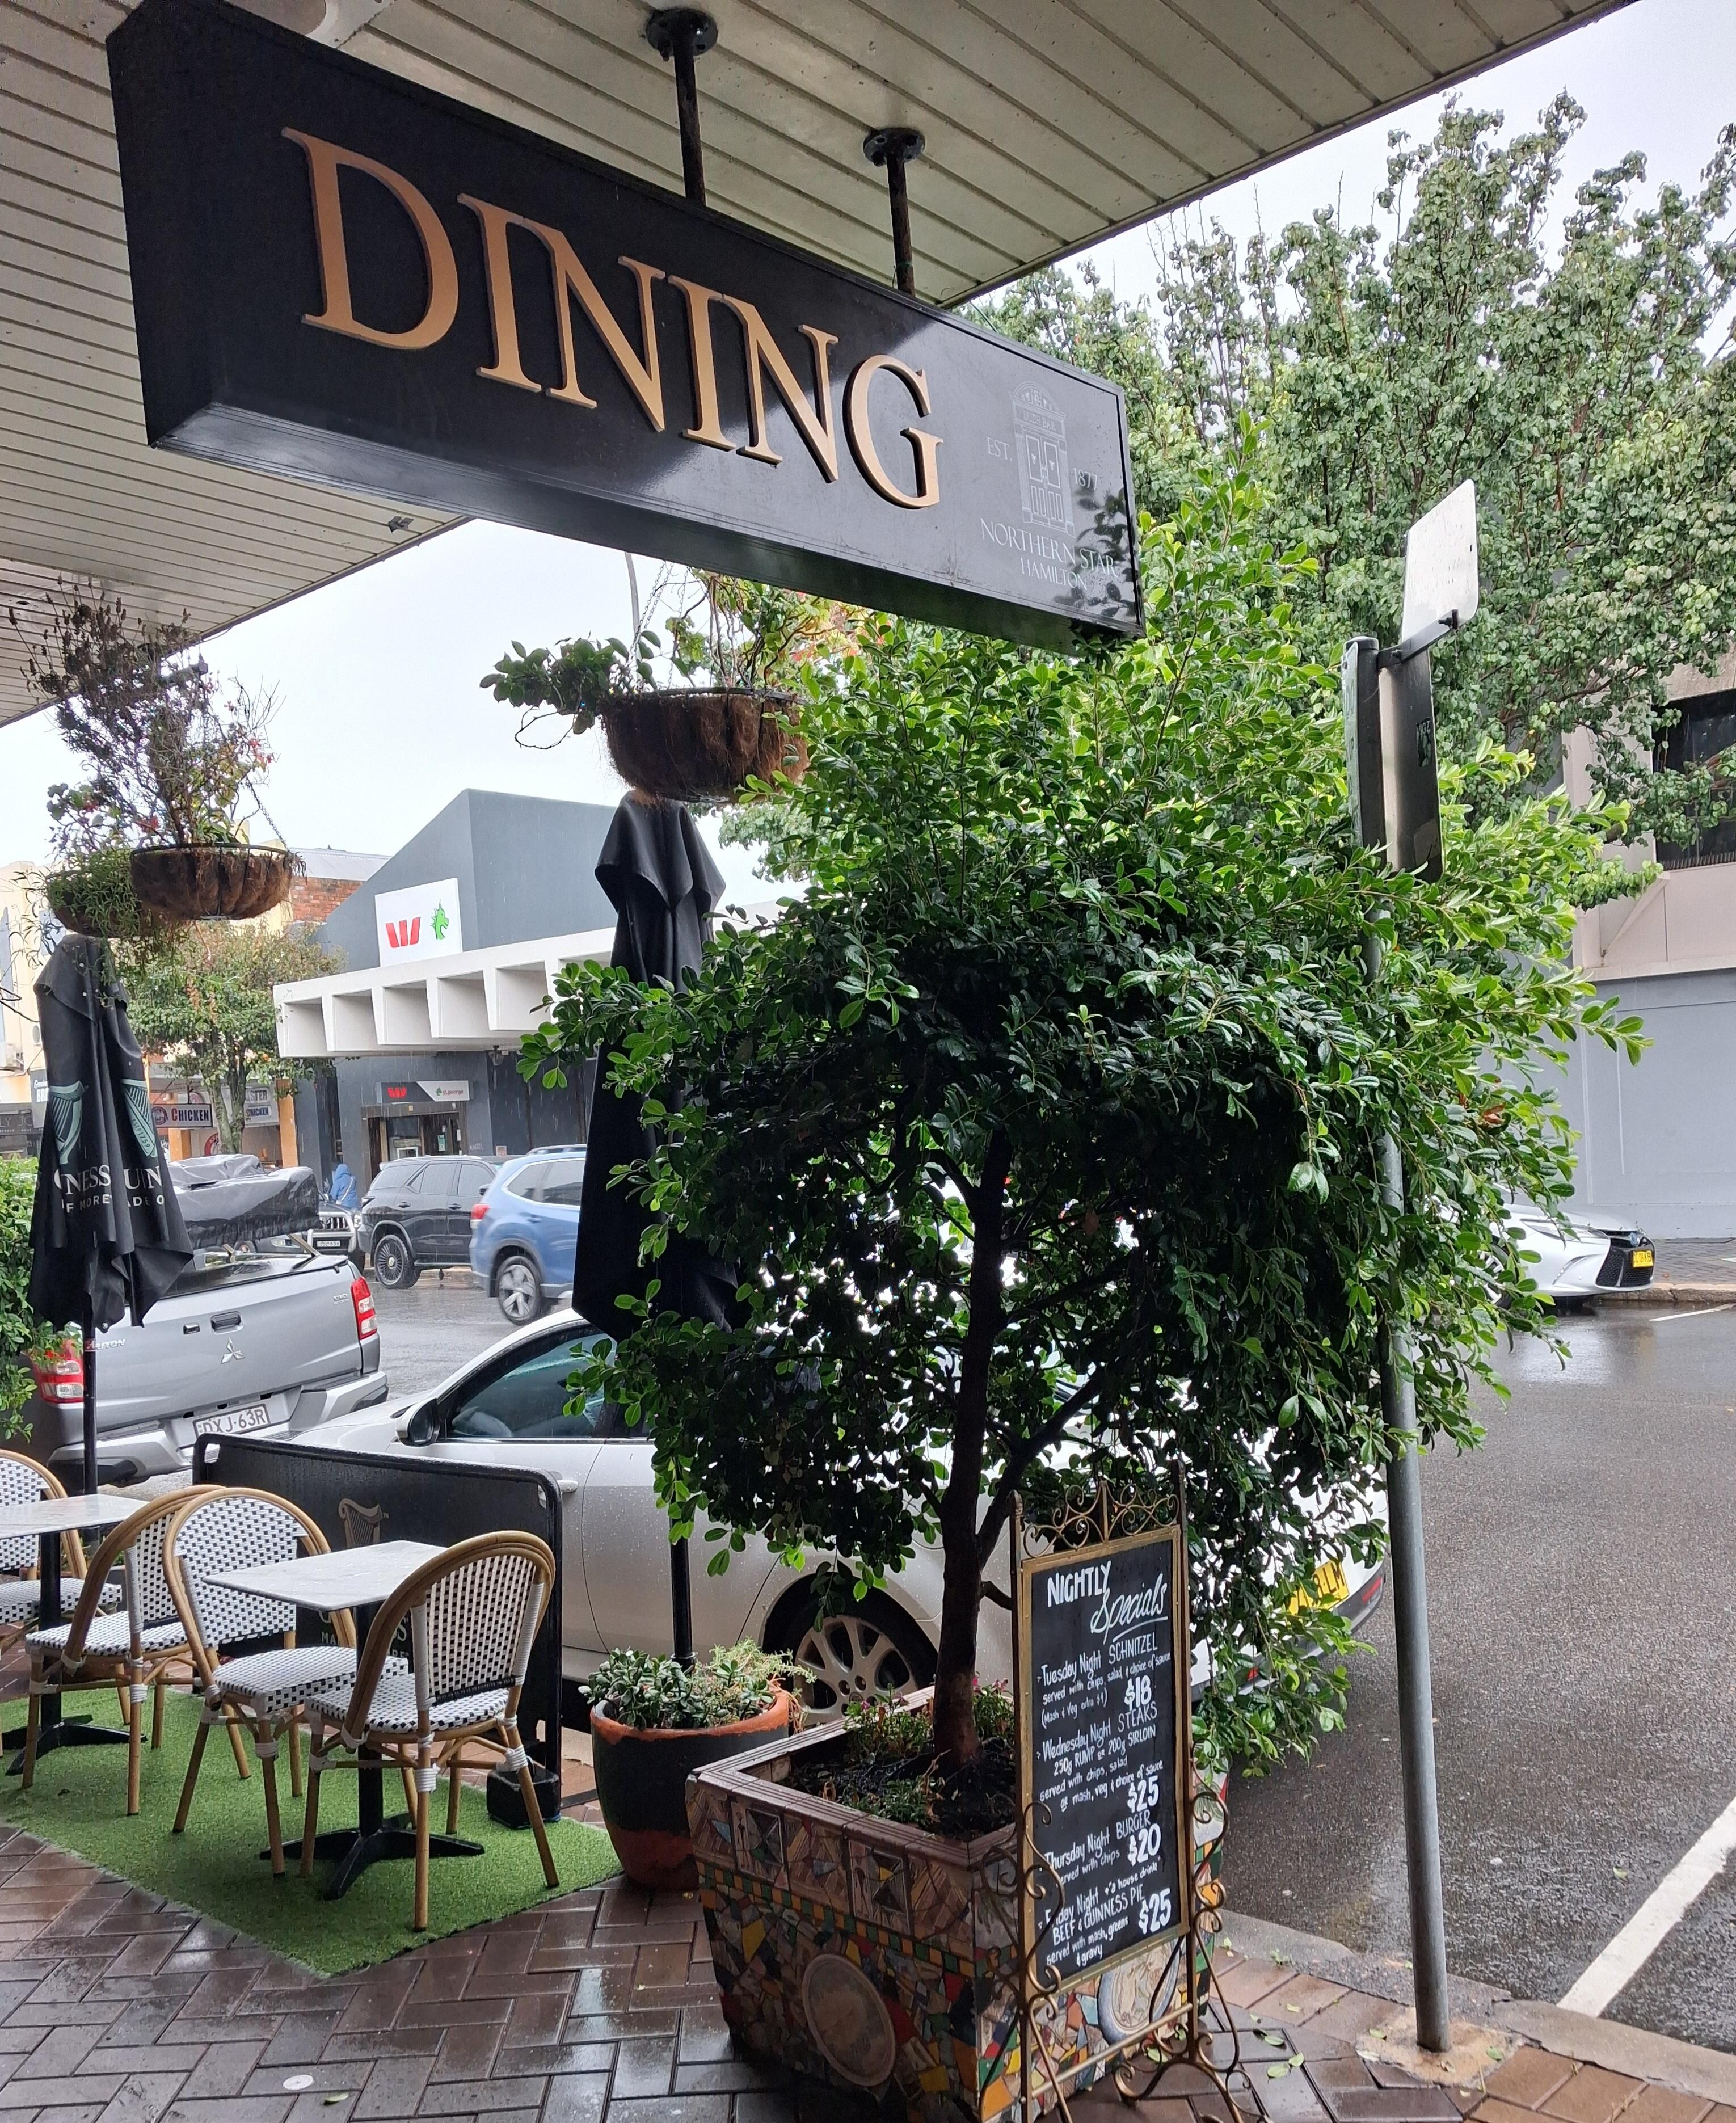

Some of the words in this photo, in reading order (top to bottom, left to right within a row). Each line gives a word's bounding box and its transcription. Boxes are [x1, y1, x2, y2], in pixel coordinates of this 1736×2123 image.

[281, 126, 943, 509] DINING
[986, 436, 1013, 461] EST.
[1073, 467, 1098, 491] 1877
[980, 517, 1076, 566] NORTHERN
[1080, 547, 1118, 578] STAR
[1021, 557, 1088, 591] HAMILTON
[171, 1108, 209, 1122] CHICKEN
[1047, 1560, 1111, 1608] NIGHTLY
[1090, 1572, 1168, 1645] Specials
[1041, 1660, 1077, 1686] Tuesday
[1079, 1649, 1101, 1680] Night
[1109, 1632, 1158, 1665] SCHNITZEL
[1043, 1684, 1065, 1705] served
[1069, 1679, 1084, 1695] with
[1130, 1661, 1147, 1675] choice
[1148, 1653, 1156, 1670] of
[1155, 1652, 1171, 1666] sauce
[1067, 1702, 1078, 1719] Veg
[1124, 1675, 1152, 1712] $18
[1043, 1729, 1089, 1762] Wednesday
[1090, 1717, 1111, 1748] Night
[1118, 1701, 1157, 1732] STEAKS
[1054, 1756, 1072, 1776] 250g
[1075, 1746, 1095, 1767] RUMP
[1108, 1737, 1126, 1756] 200g
[1128, 1724, 1156, 1747] SIRLOIN
[1039, 1779, 1066, 1802] served
[1068, 1772, 1083, 1788] with
[1109, 1755, 1128, 1773] salad
[1095, 1783, 1108, 1798] veg
[1116, 1772, 1135, 1788] choice
[1137, 1764, 1145, 1780] of
[1146, 1760, 1163, 1776] sauce
[1127, 1775, 1159, 1813] $25
[1044, 1842, 1085, 1870] Thursday
[1088, 1826, 1110, 1858] Night
[1116, 1809, 1151, 1839] BURGER
[1127, 1823, 1161, 1867] $20
[1059, 1865, 1079, 1885] erved
[1082, 1858, 1098, 1875] with
[1101, 1849, 1120, 1865] chips
[1118, 1873, 1138, 1890] house
[1046, 1905, 1074, 1926] Fiday
[1077, 1886, 1098, 1915] Night
[1053, 1919, 1076, 1946] BEEF
[1084, 1892, 1128, 1929] GUINNESS
[1130, 1884, 1145, 1906] PIE
[1138, 1887, 1172, 1935] $25
[1046, 1941, 1070, 1965] served
[1072, 1935, 1086, 1952] with
